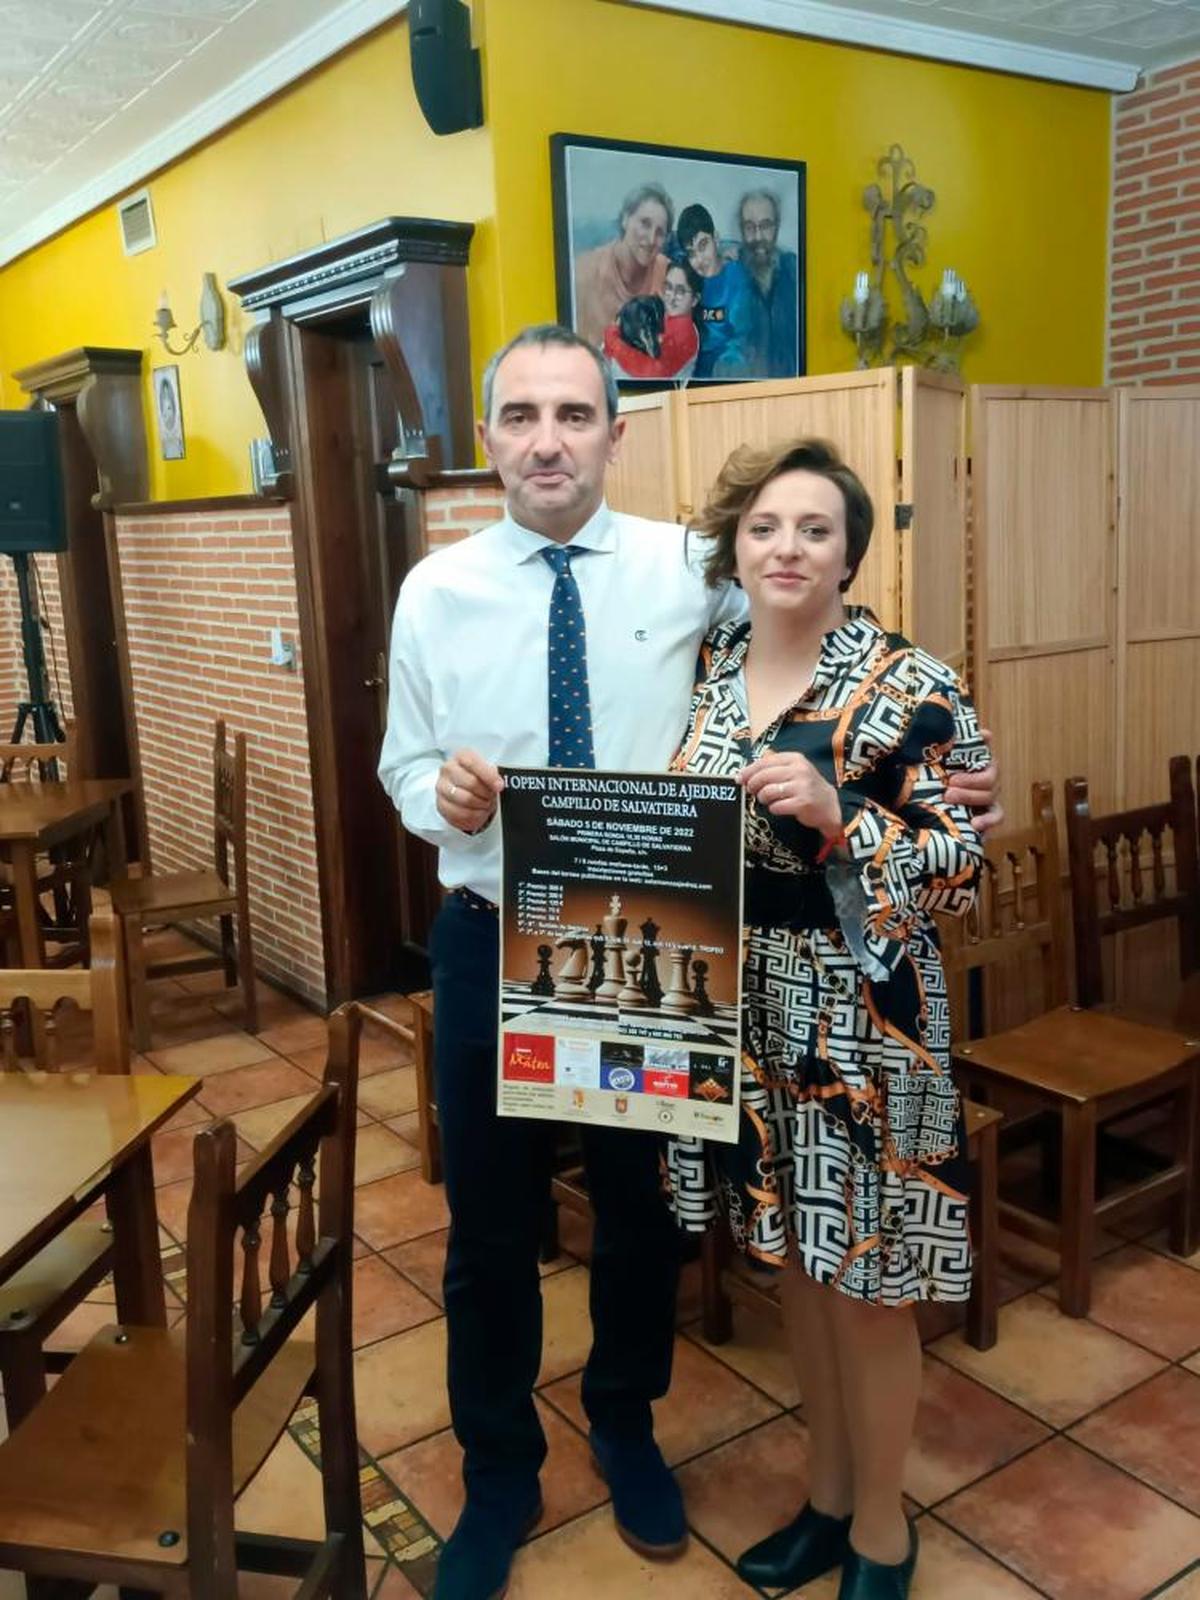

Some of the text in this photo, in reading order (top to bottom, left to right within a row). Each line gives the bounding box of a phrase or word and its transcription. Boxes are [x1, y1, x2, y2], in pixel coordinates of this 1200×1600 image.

[510, 775, 546, 790] OPEN
[548, 777, 657, 796] INTERNACIONAL
[658, 781, 677, 797] DE
[678, 783, 737, 802] AJEDREZ
[541, 795, 698, 818] CAMPILLO DE SALVATIERRA
[546, 817, 695, 838] SÁBADO 5 DE NOVIEMBRE DE 2022
[611, 839, 640, 848] CAMPILLO
[651, 843, 692, 852] SALVATIERRA
